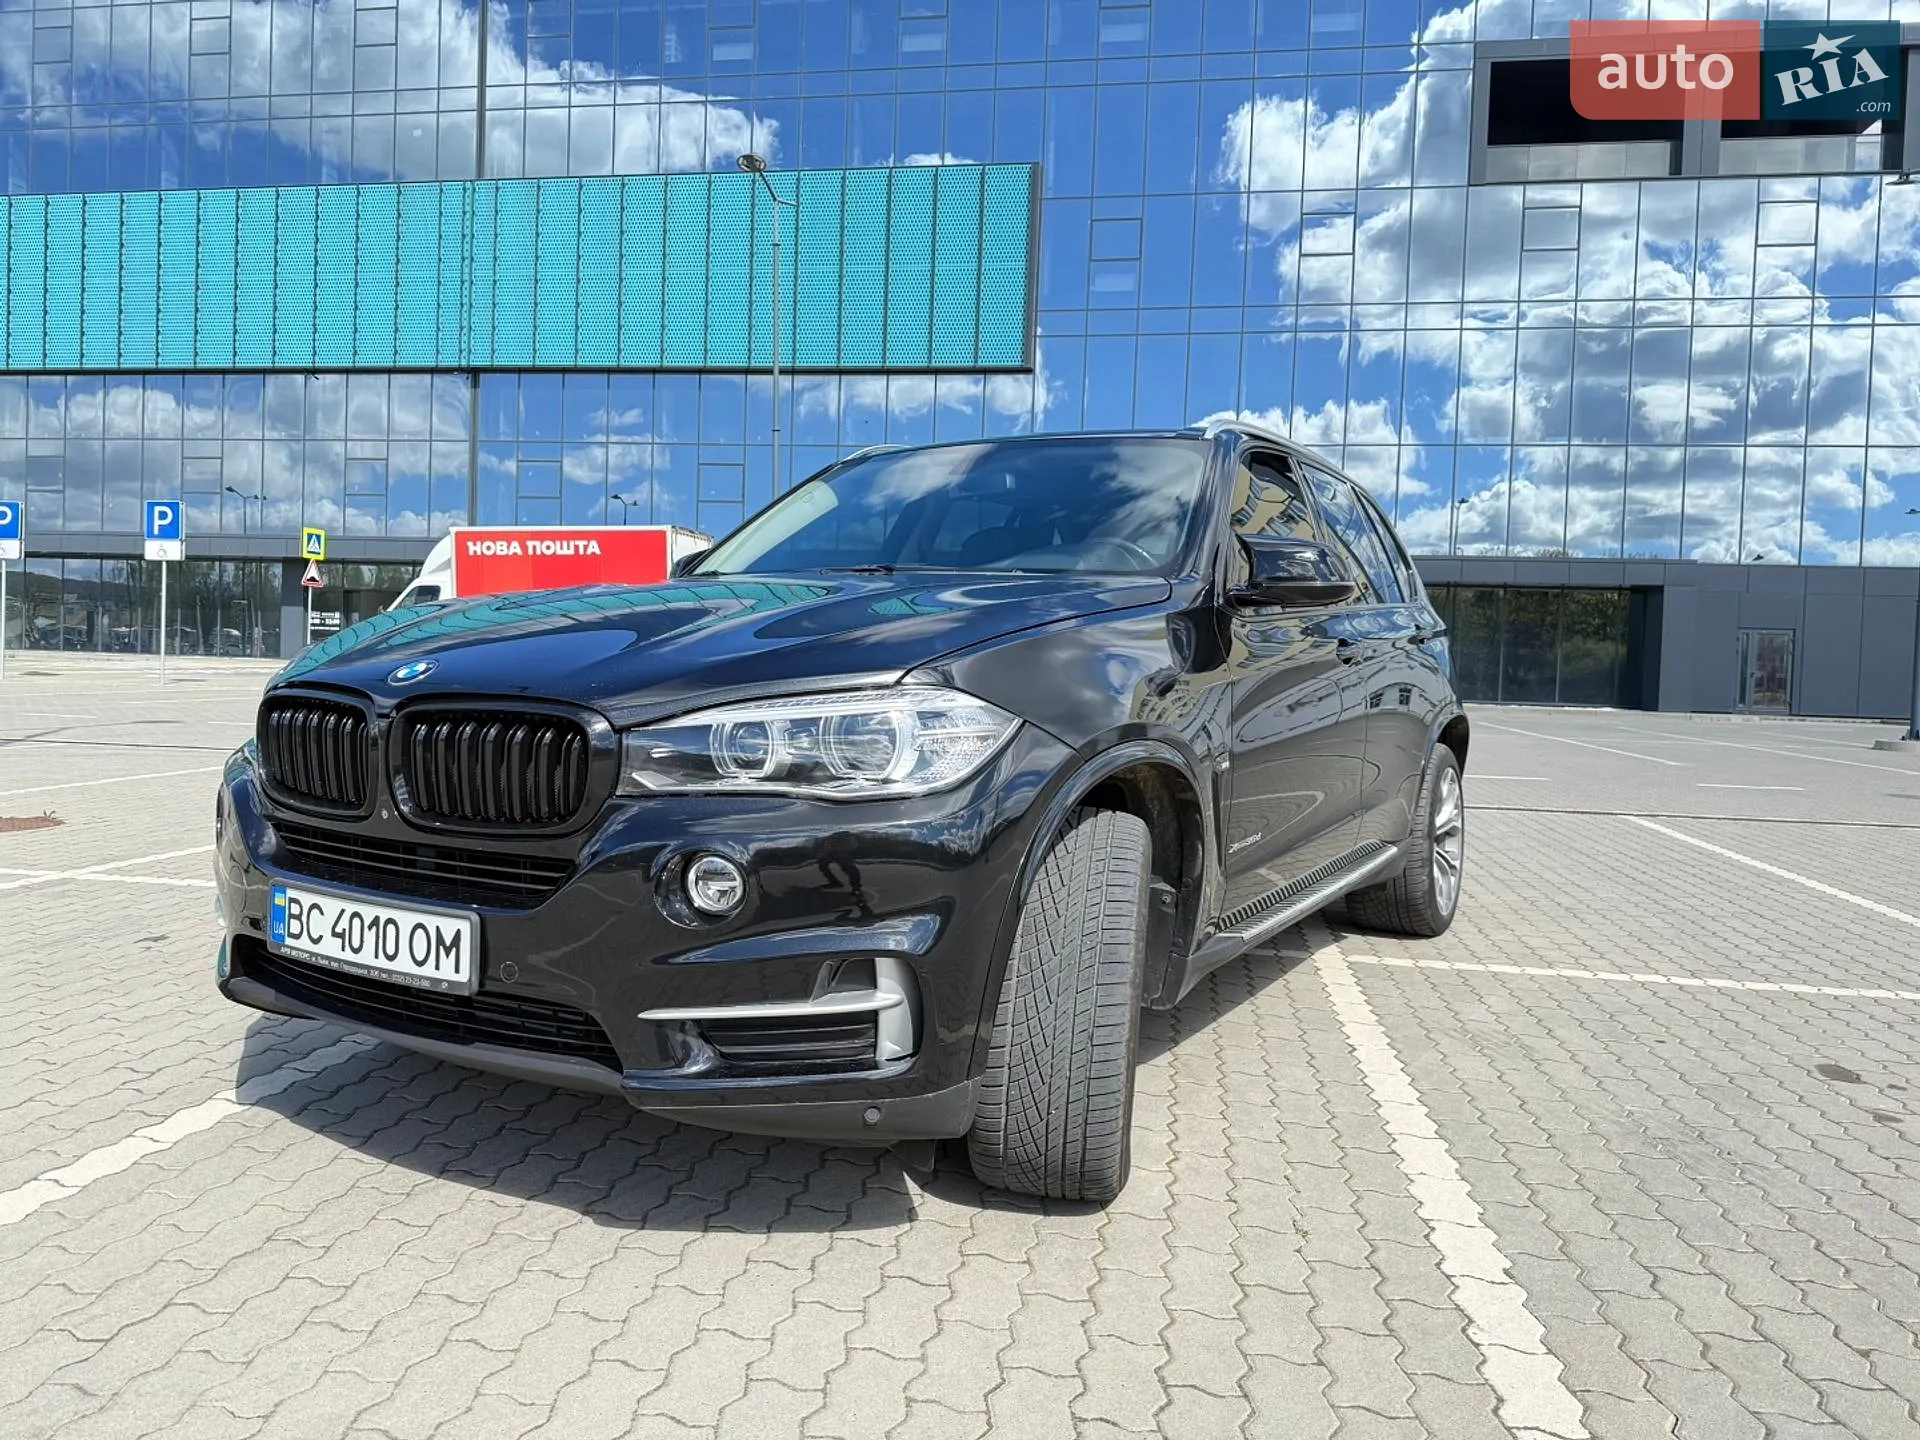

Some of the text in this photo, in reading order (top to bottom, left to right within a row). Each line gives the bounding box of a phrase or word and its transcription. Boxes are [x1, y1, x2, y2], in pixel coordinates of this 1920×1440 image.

[153, 505, 173, 535] P
[466, 540, 601, 556] НОВА ПОШТА
[273, 922, 284, 935] UA
[286, 896, 462, 975] BC 4010 OM
